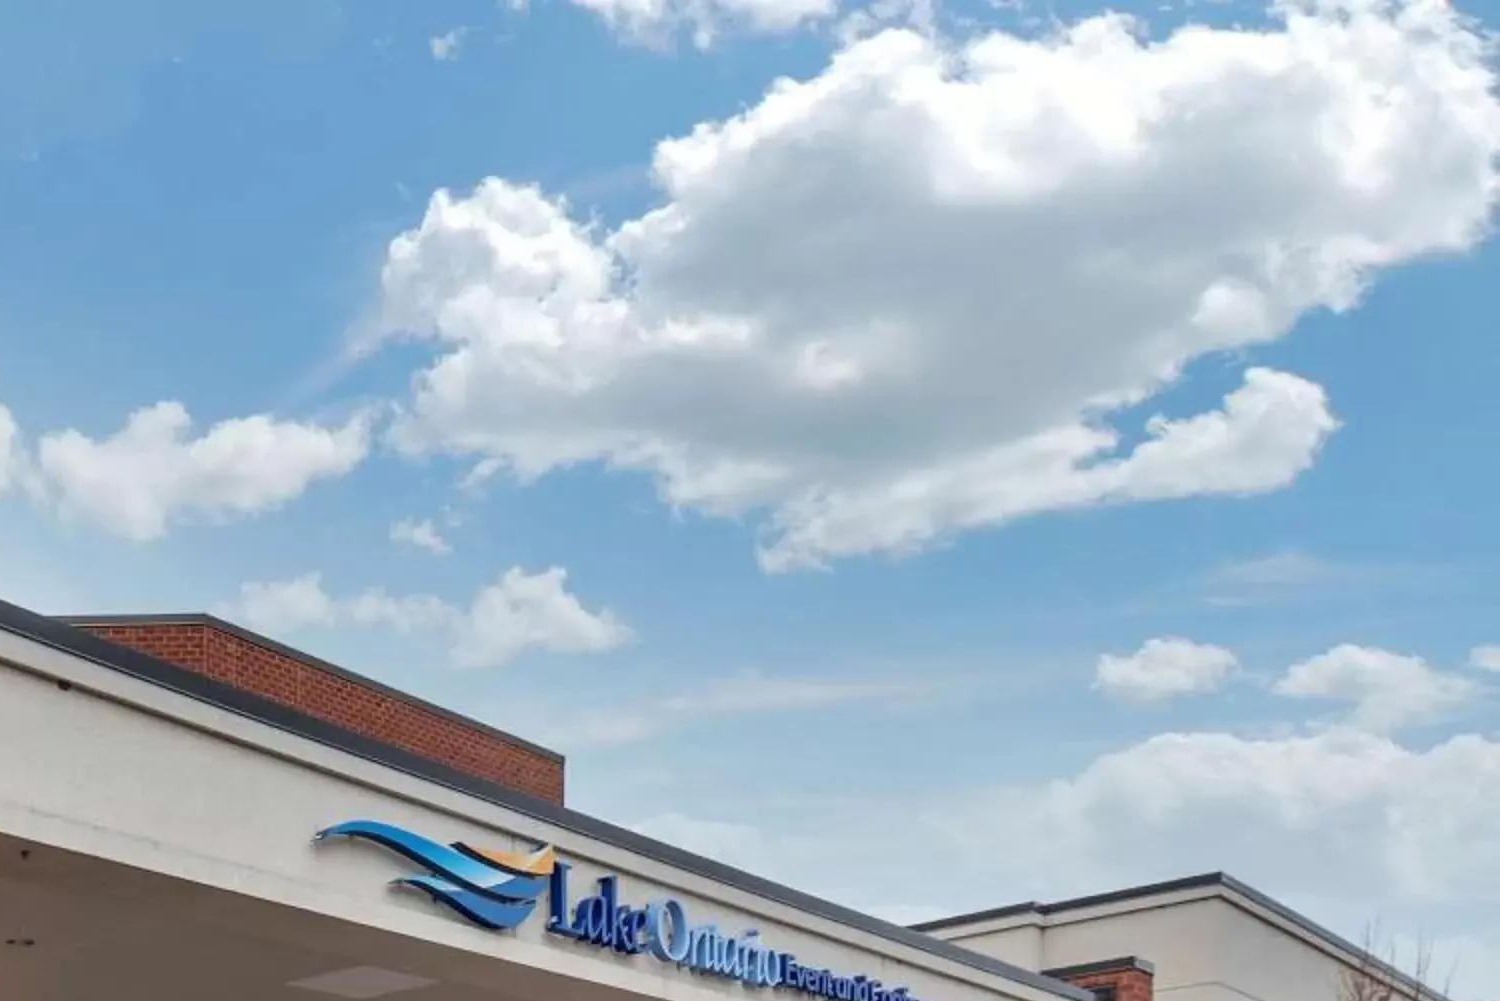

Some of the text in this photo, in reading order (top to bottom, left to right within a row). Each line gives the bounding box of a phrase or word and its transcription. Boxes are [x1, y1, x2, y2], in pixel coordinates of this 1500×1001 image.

[547, 861, 649, 953] Lake
[647, 898, 783, 987] Ontario
[779, 953, 835, 997] Event
